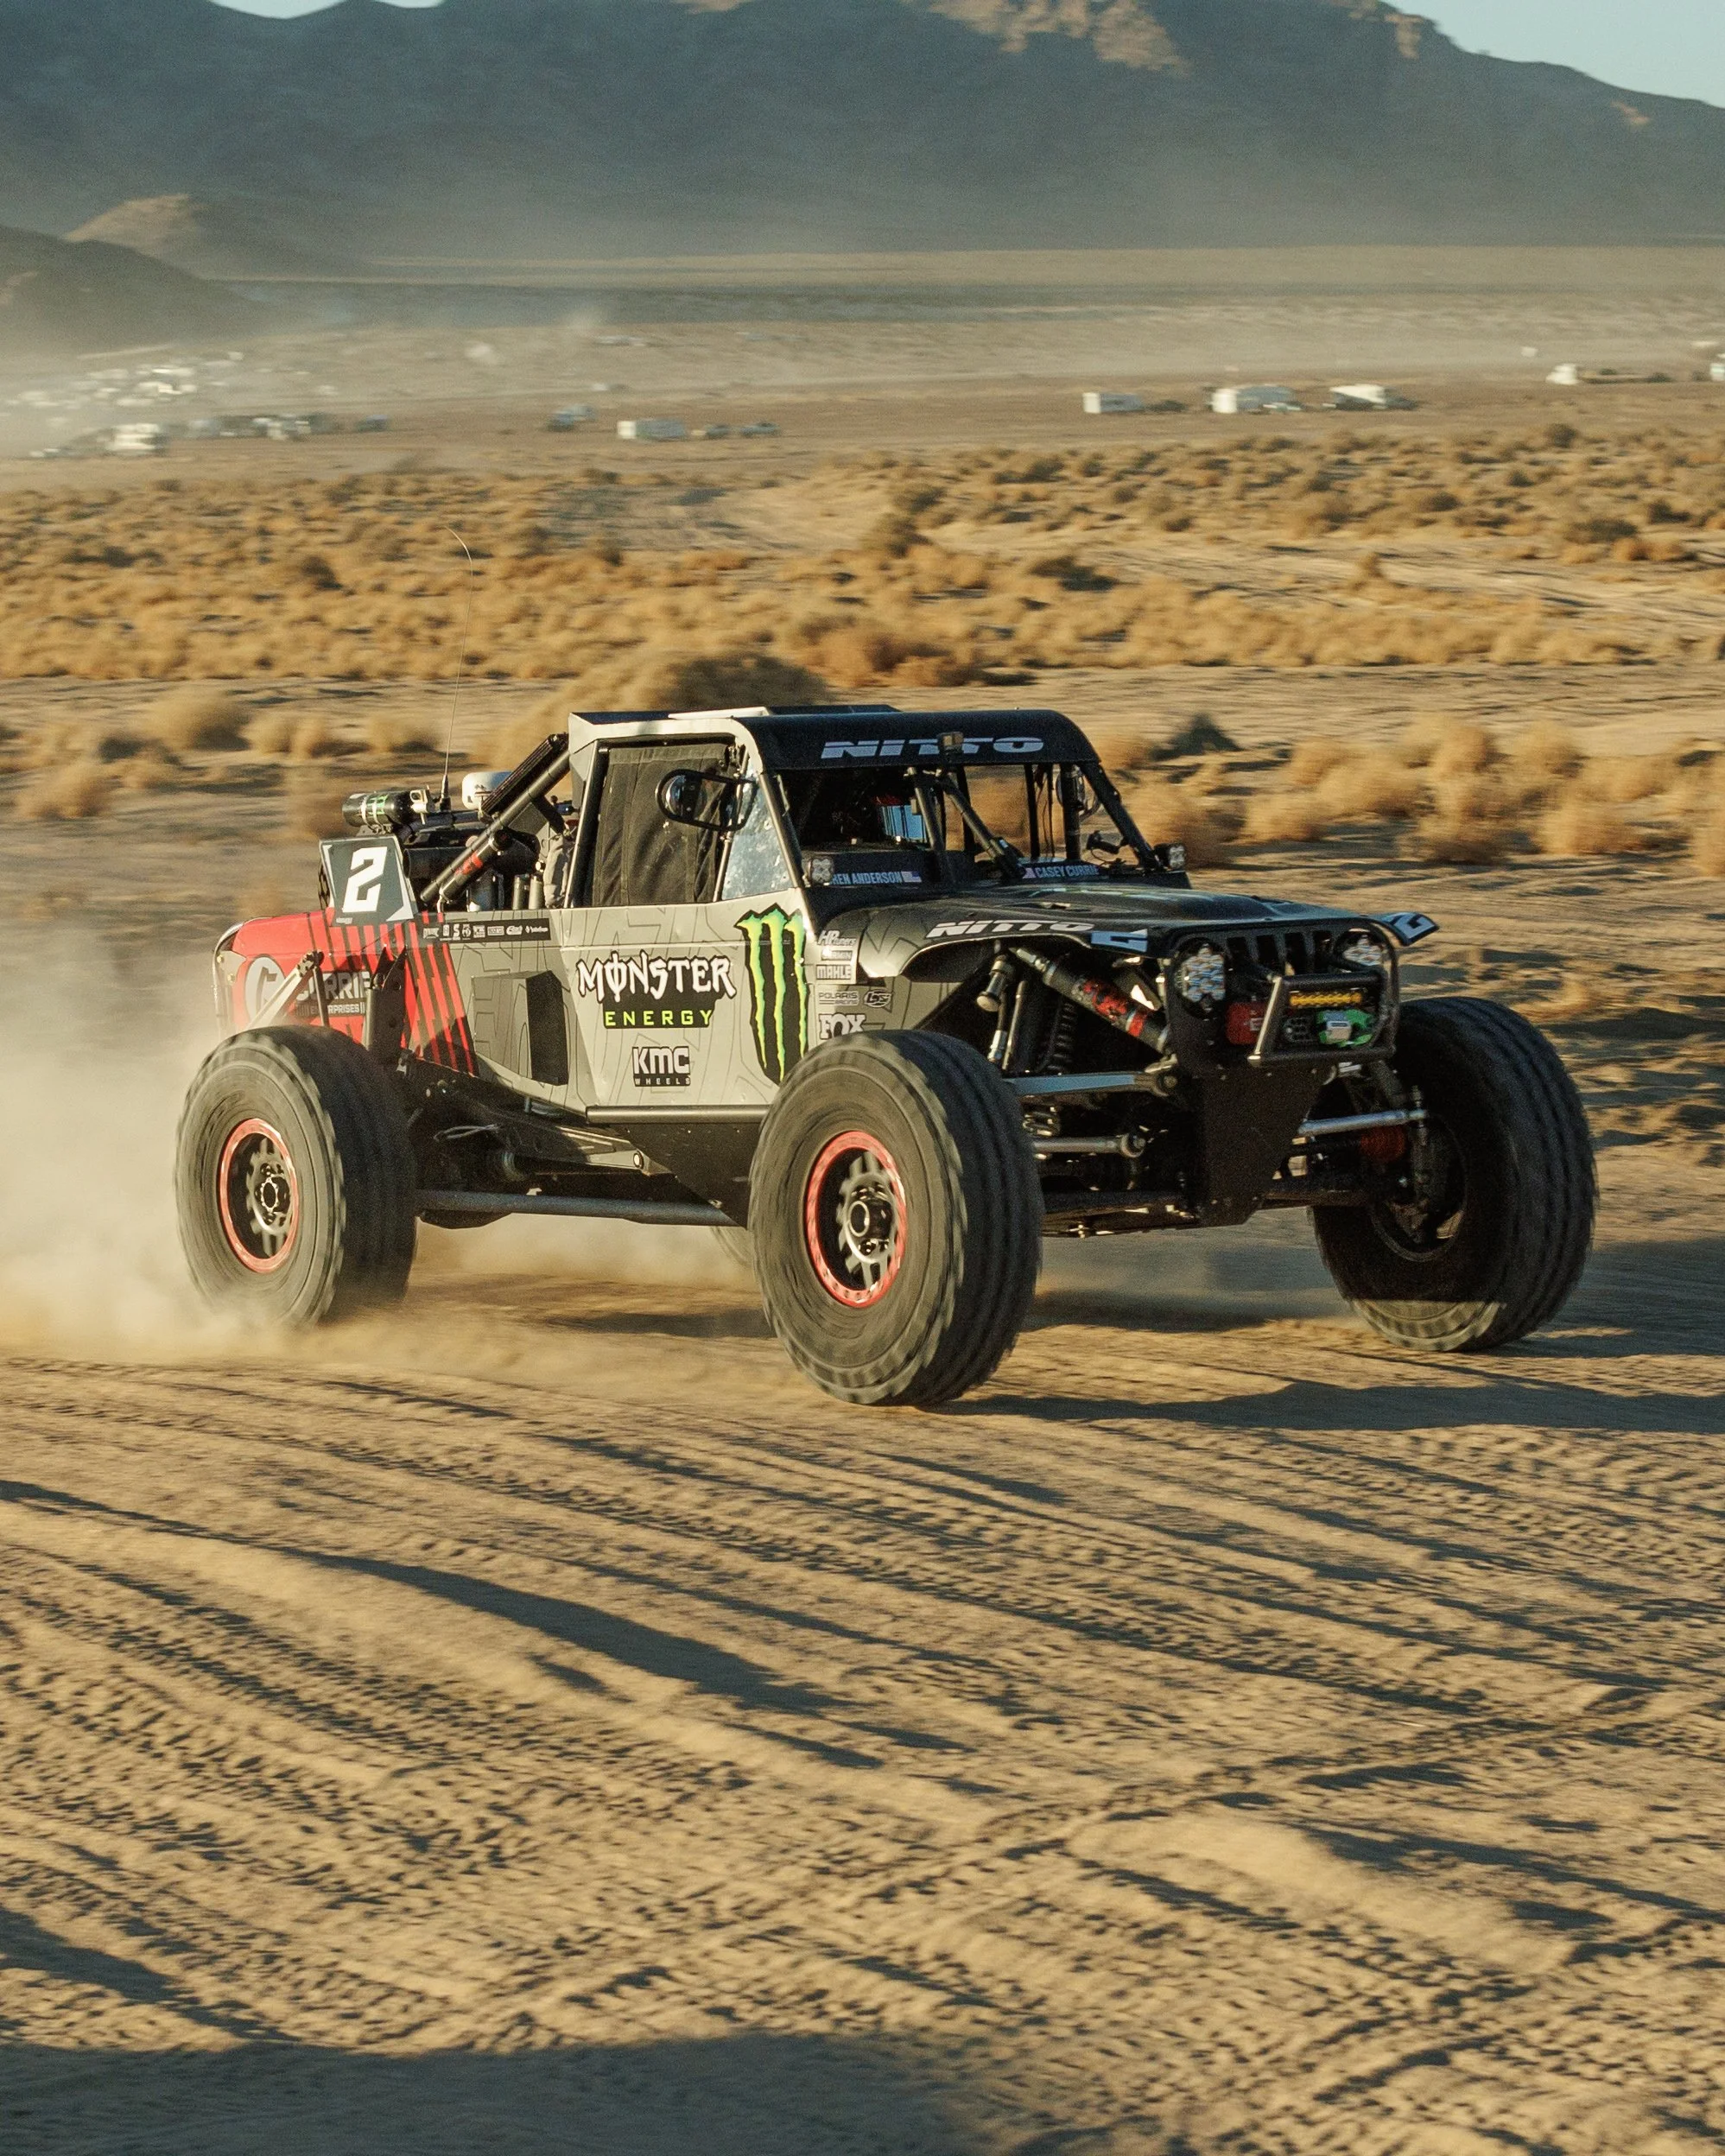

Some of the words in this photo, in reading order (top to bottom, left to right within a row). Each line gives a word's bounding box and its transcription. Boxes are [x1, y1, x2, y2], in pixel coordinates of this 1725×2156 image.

[821, 737, 1043, 758] NITTO
[342, 847, 387, 913] 2
[852, 872, 902, 885] ANDERSON
[1036, 866, 1065, 878] CASEY
[926, 920, 1094, 939] NITTO
[577, 951, 736, 1002] MONSTER
[816, 965, 851, 980] MAHLE
[605, 1010, 712, 1025] ENERGY
[819, 1013, 866, 1038] FOX
[632, 1048, 689, 1074] KMC
